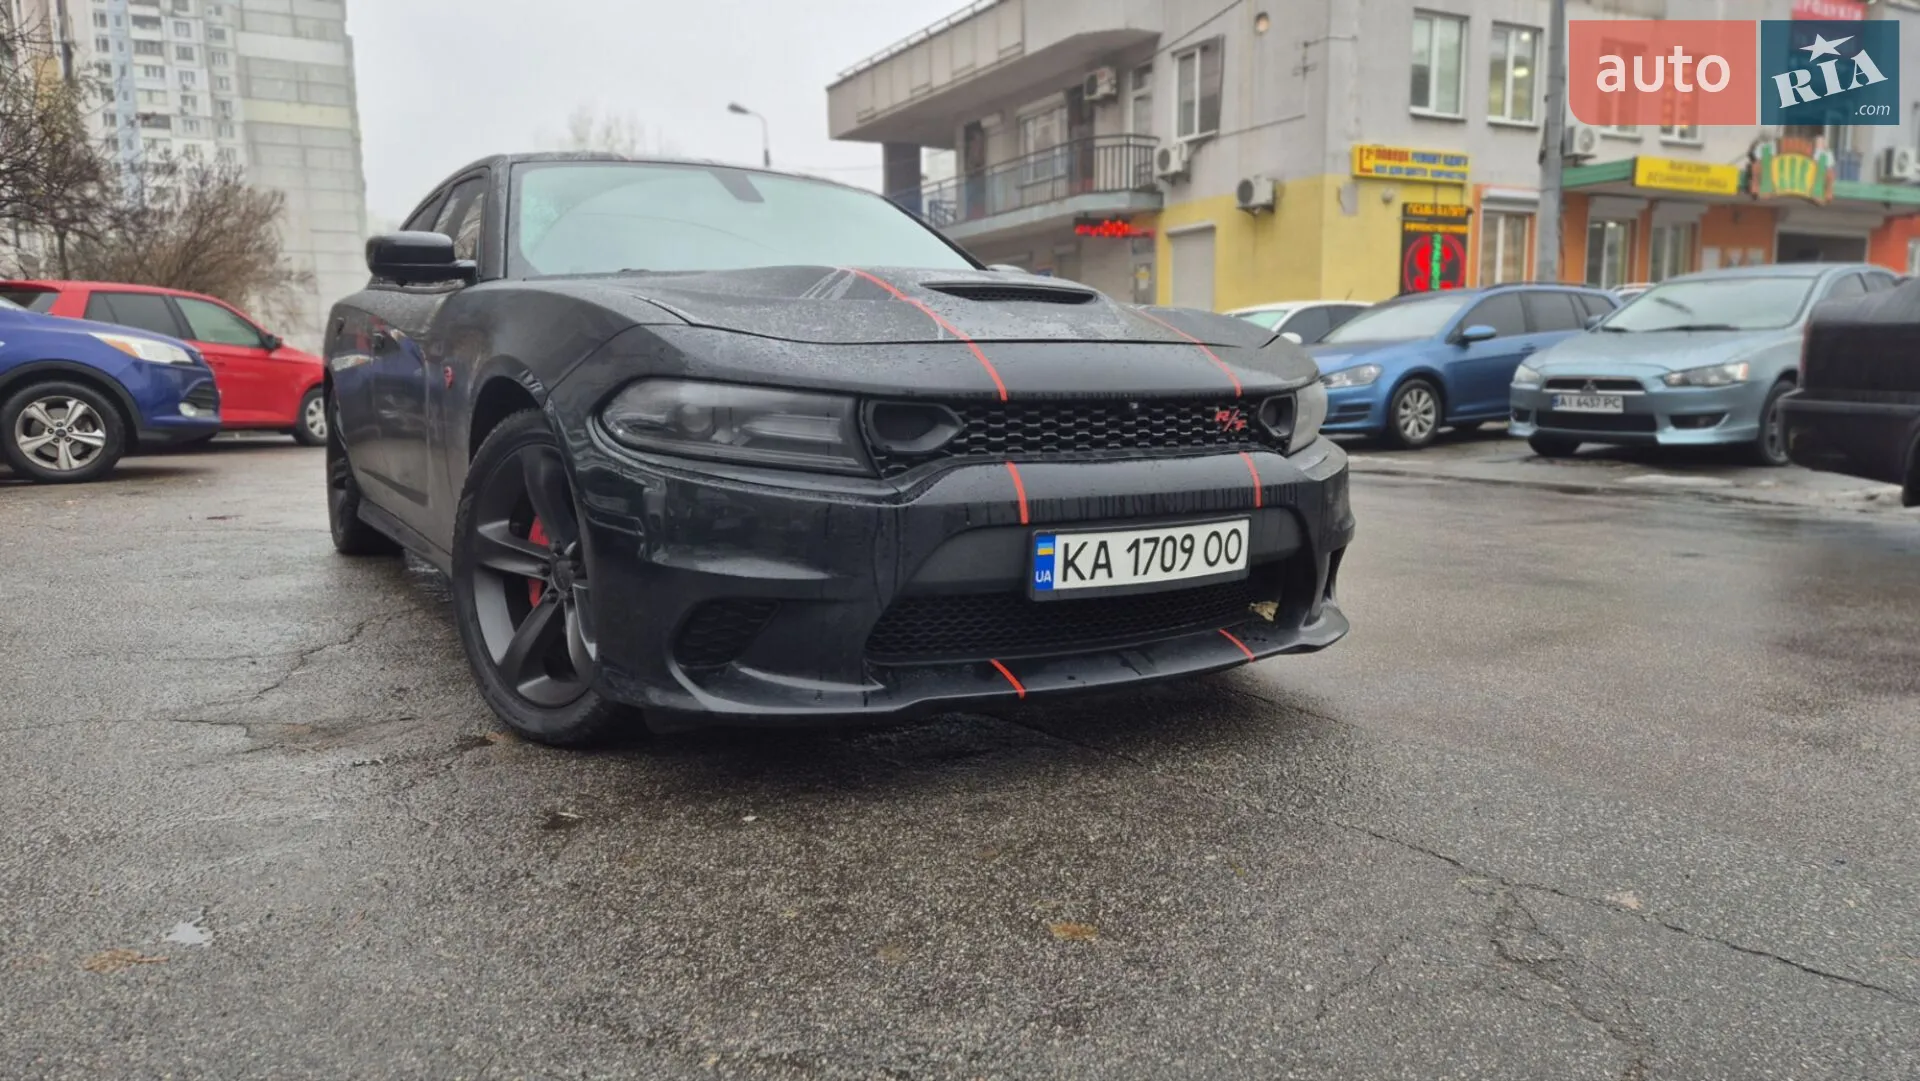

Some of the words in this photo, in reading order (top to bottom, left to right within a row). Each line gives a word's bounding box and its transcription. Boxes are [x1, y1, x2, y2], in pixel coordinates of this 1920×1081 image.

[1062, 541, 1113, 582] KA
[1126, 533, 1195, 577] 1709
[1035, 570, 1052, 583] UA
